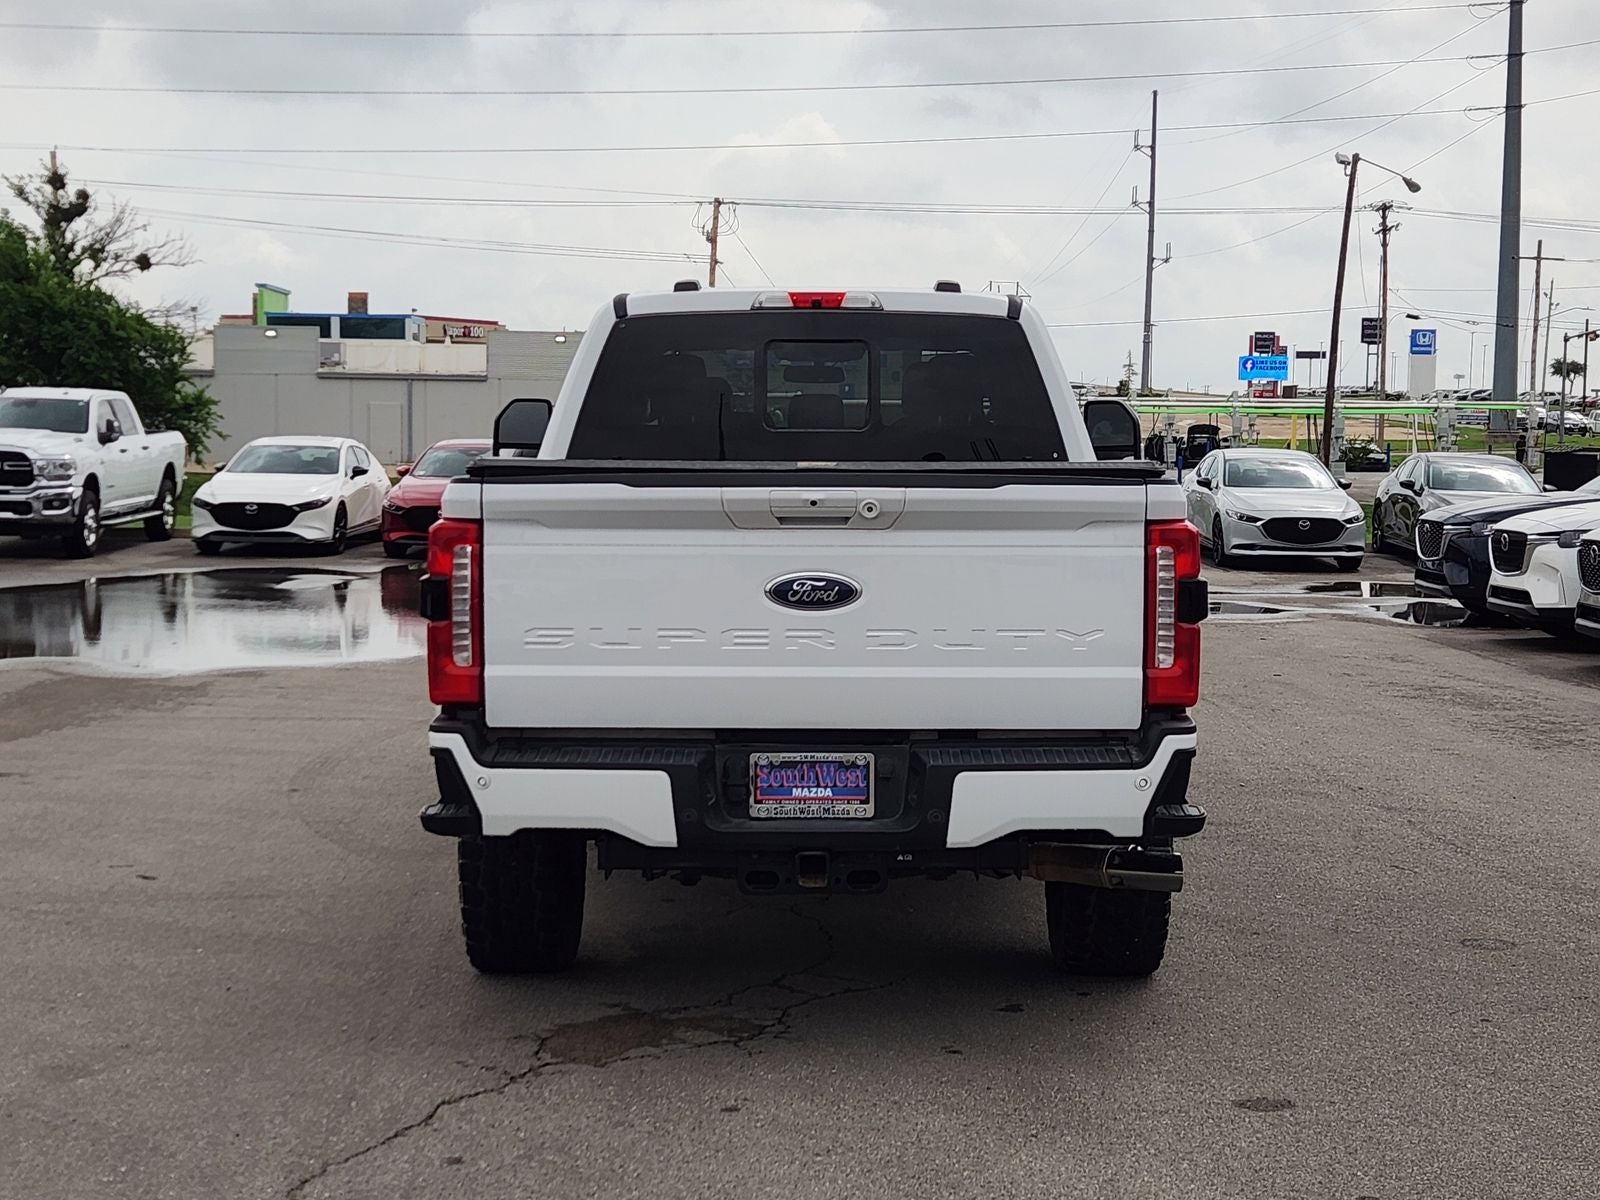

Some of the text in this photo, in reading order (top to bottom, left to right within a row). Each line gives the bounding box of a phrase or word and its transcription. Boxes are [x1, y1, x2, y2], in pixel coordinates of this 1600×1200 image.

[470, 327, 484, 337] 100
[787, 579, 840, 602] Ford
[524, 627, 1105, 651] SUPER DUTY
[792, 788, 833, 797] MAZDA
[822, 806, 851, 816] Mazda
